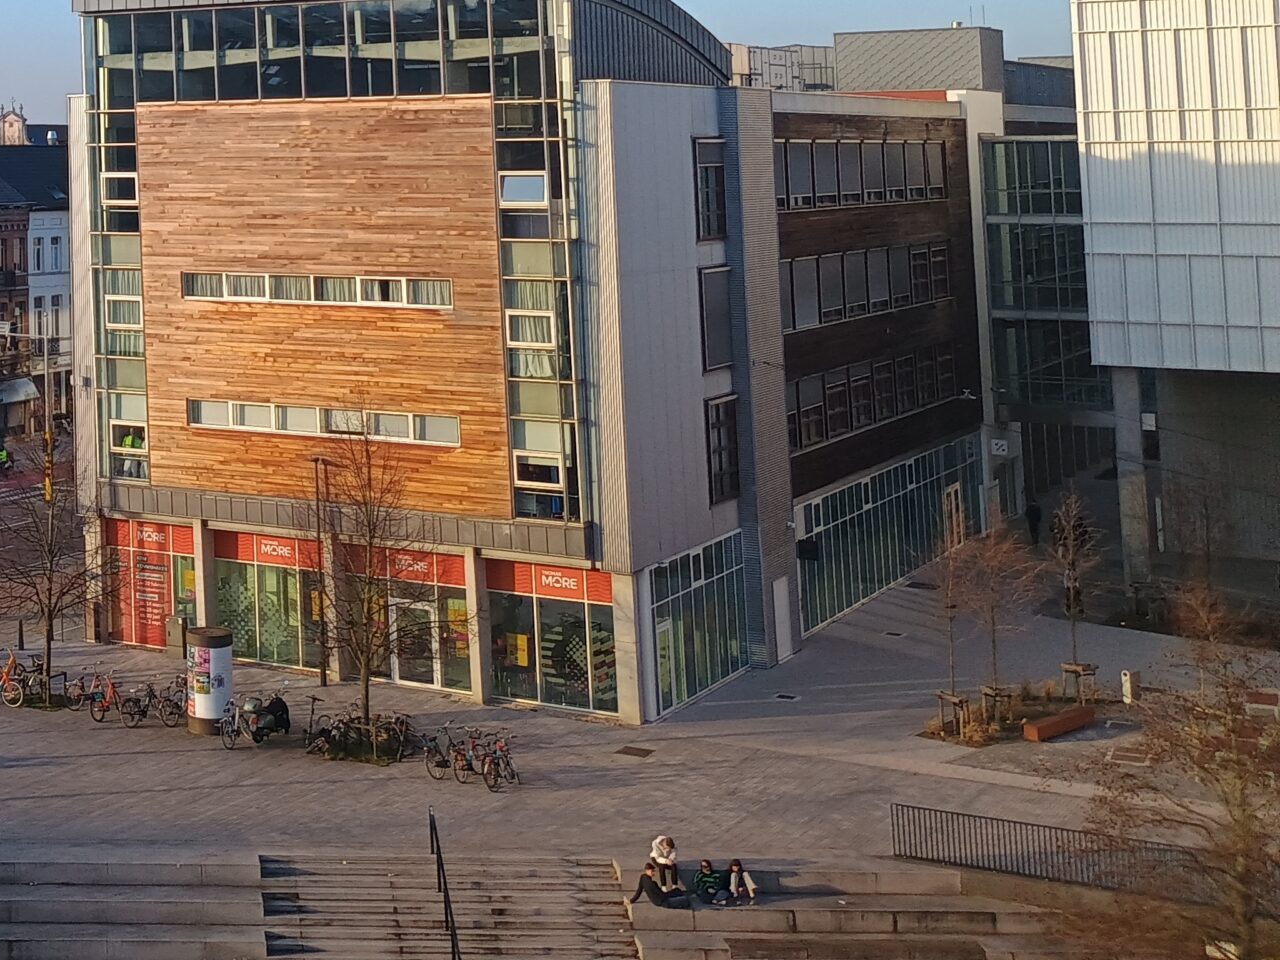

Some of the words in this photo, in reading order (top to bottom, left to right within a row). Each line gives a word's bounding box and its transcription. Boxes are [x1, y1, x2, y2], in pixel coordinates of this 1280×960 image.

[137, 530, 166, 543] MORE
[260, 544, 291, 557] MORE
[395, 559, 429, 573] MORE
[541, 575, 578, 590] MORE
